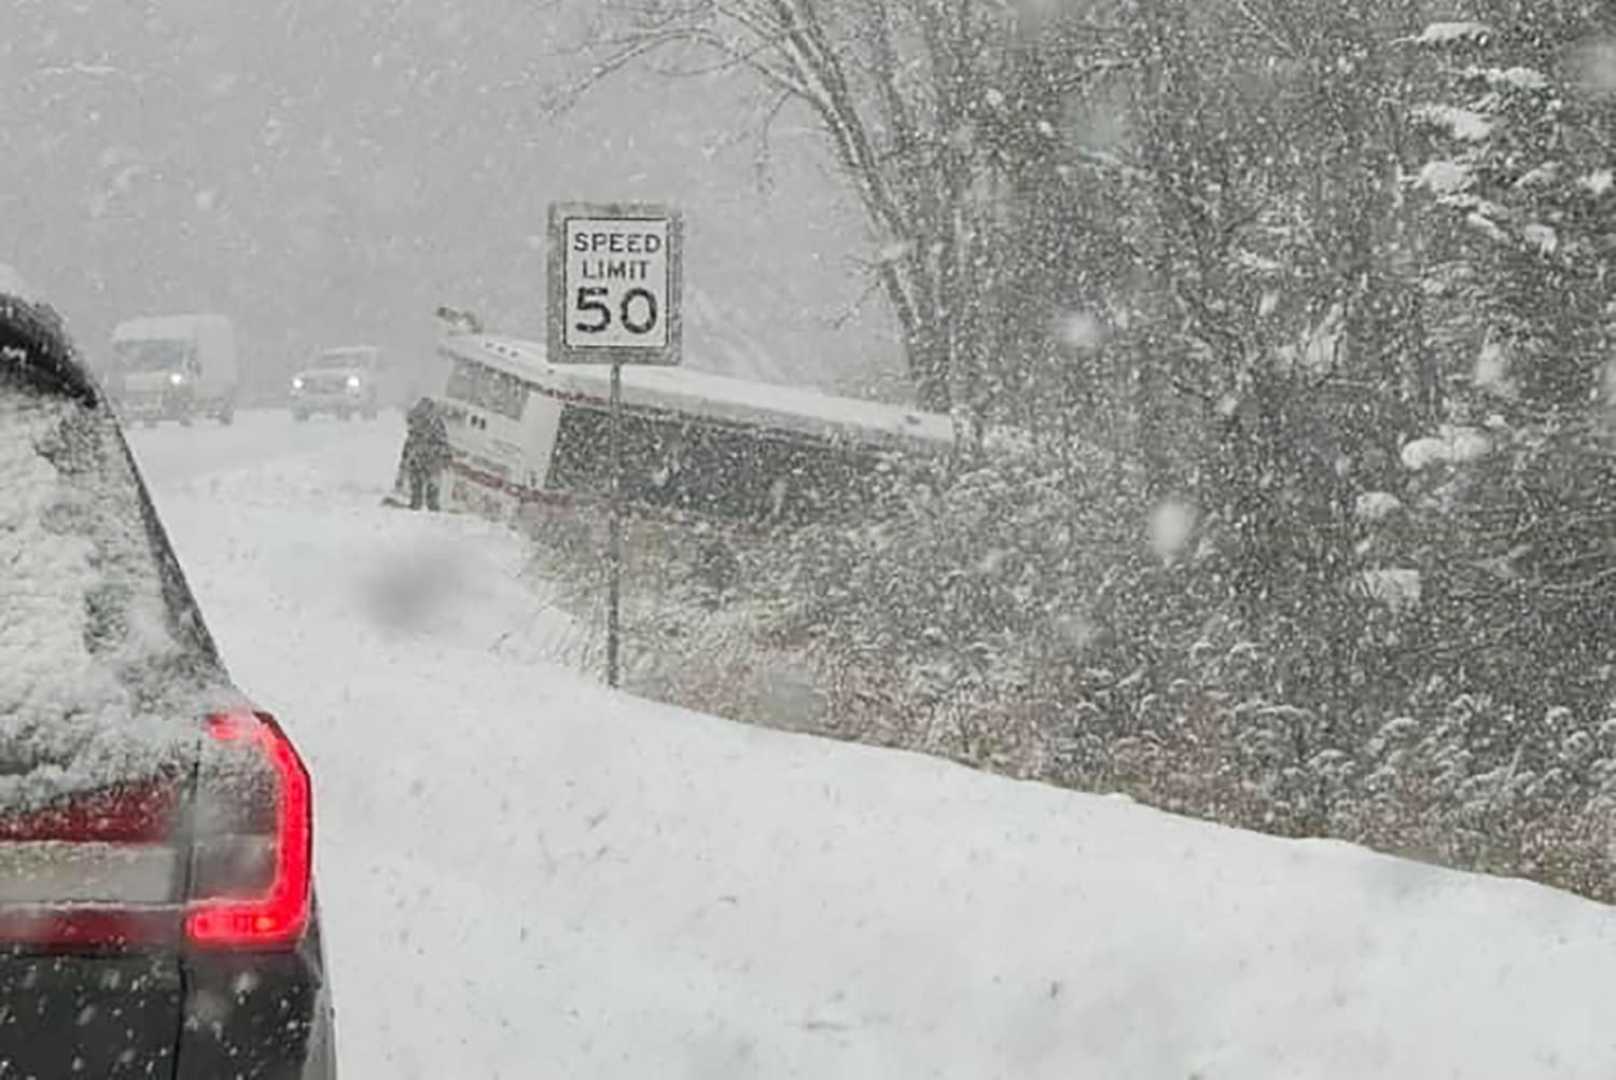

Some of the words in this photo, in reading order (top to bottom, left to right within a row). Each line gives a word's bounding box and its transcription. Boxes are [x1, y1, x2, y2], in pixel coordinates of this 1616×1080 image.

[573, 232, 661, 253] SPEED
[582, 259, 651, 280] LIMIT
[575, 286, 658, 335] 50
